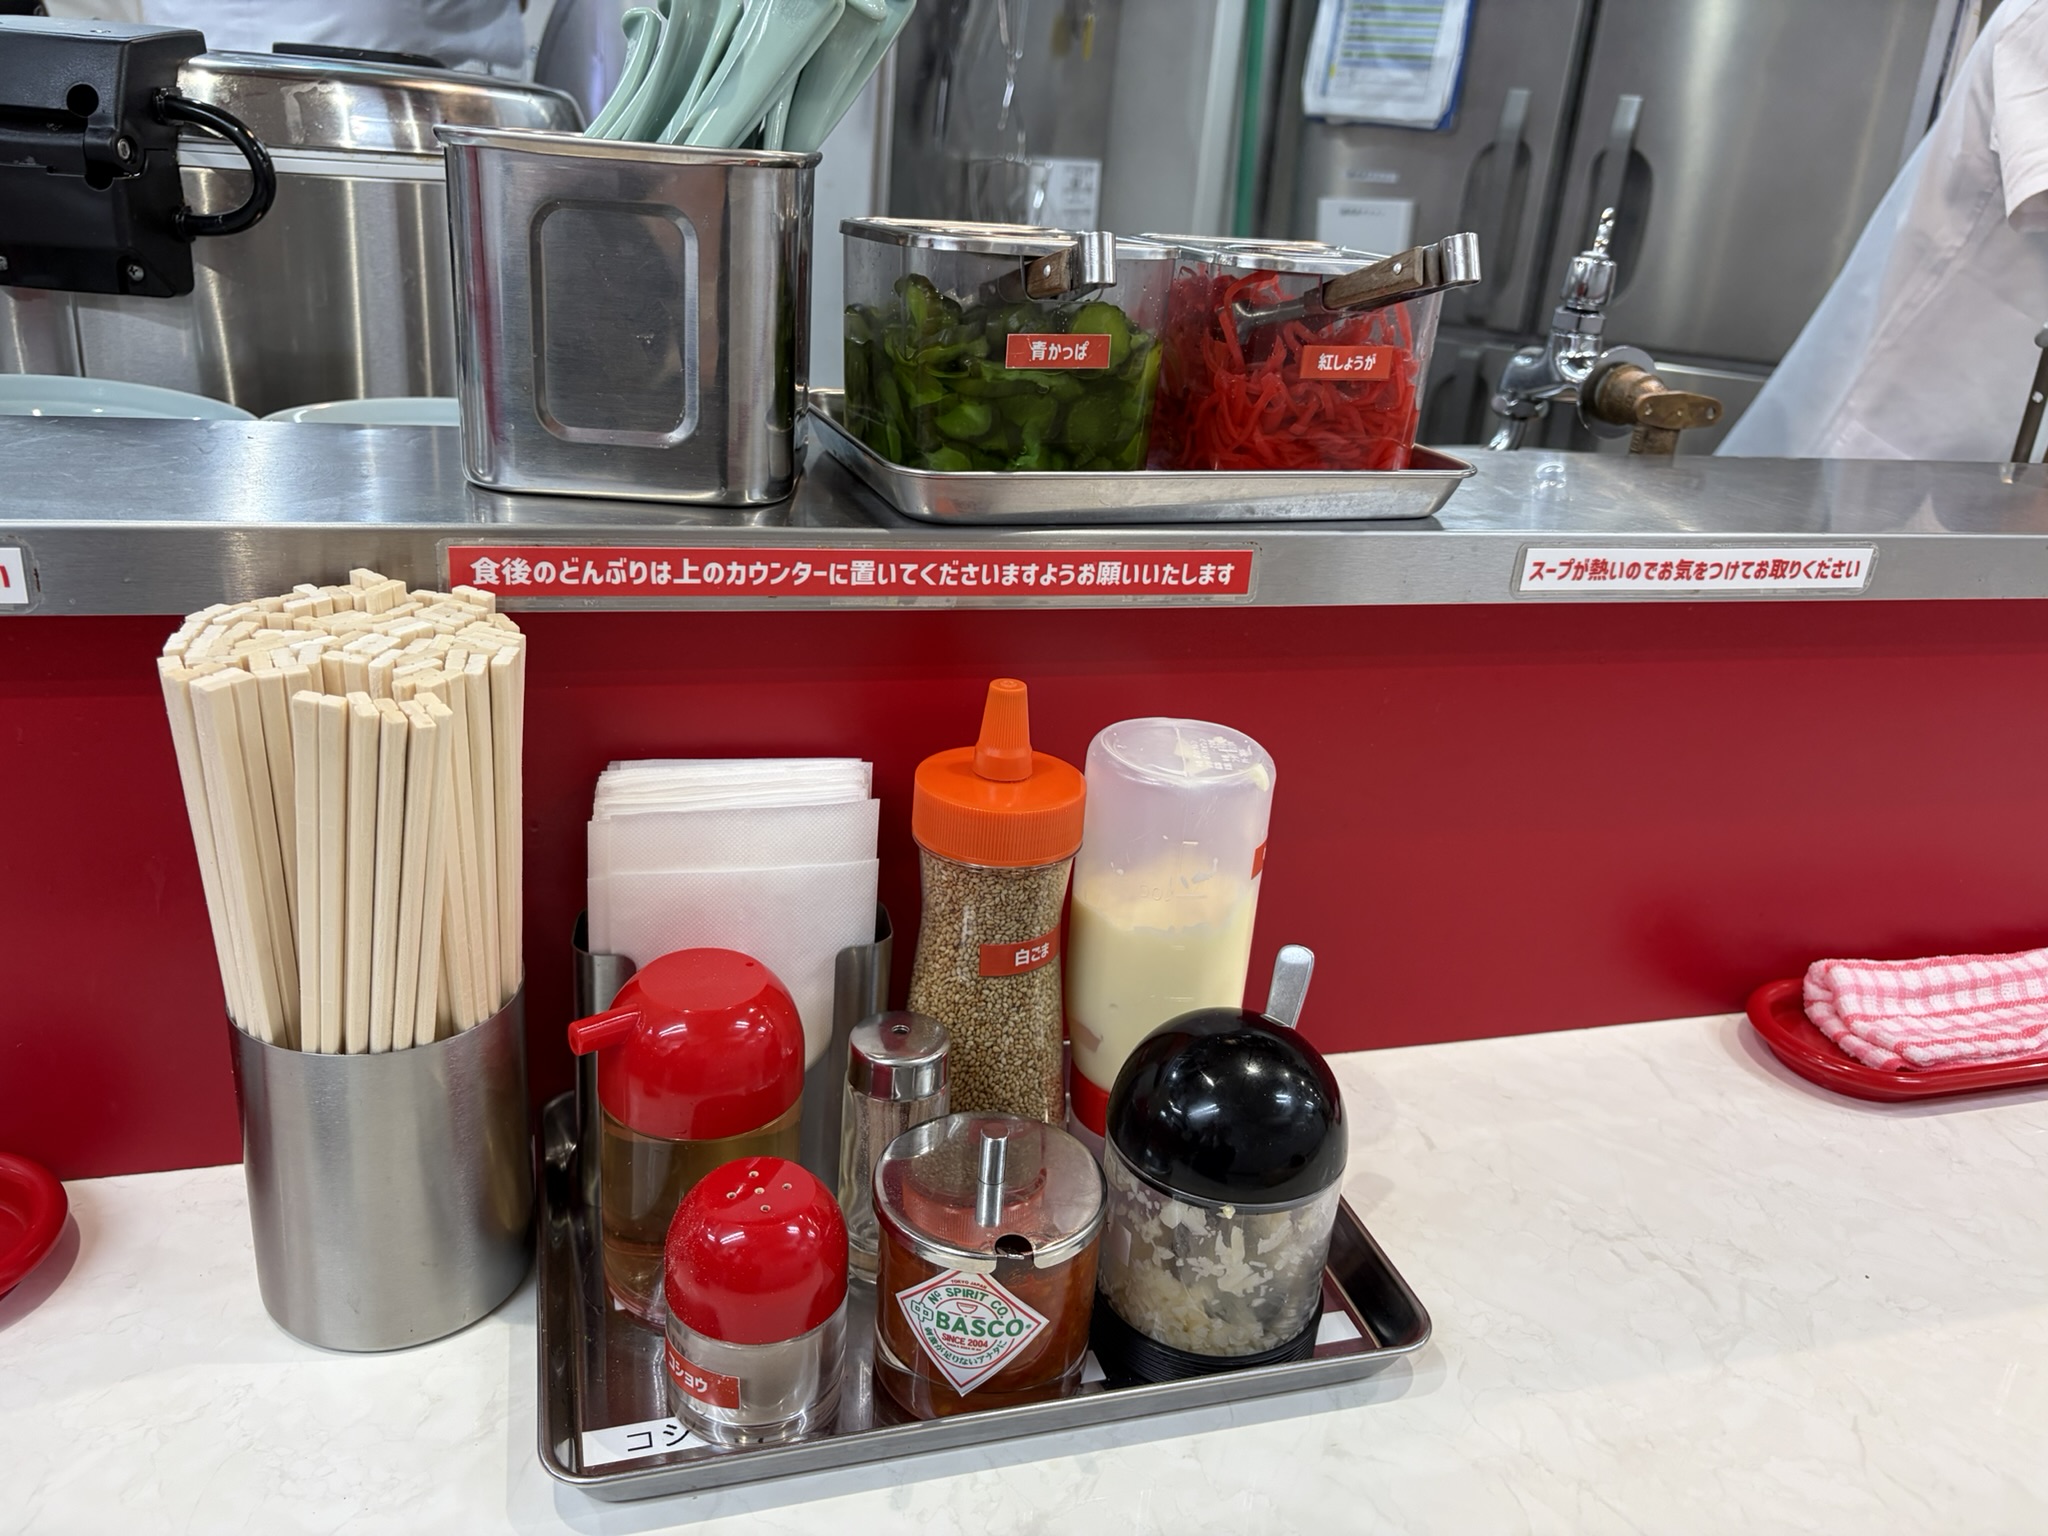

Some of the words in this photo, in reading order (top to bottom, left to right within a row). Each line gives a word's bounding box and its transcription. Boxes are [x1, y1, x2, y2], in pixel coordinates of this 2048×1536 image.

[1031, 340, 1090, 361] 青かっぱ
[1317, 352, 1377, 371] 紅しょうが
[469, 556, 1236, 587] 食後のどんぶりは上のカウンターに置いてくださいますようお願いいたします
[1528, 557, 1860, 582] スープが熱いのでお気をつけてお取りください
[1014, 942, 1050, 967] 白ごま
[945, 1287, 989, 1301] SPIRIT
[990, 1300, 1009, 1319] CO.
[935, 1310, 1024, 1338] BASCO
[941, 1332, 966, 1346] SINCE
[967, 1338, 989, 1348] 2004
[668, 1350, 708, 1393] コショウ
[626, 1423, 691, 1452] コシ
